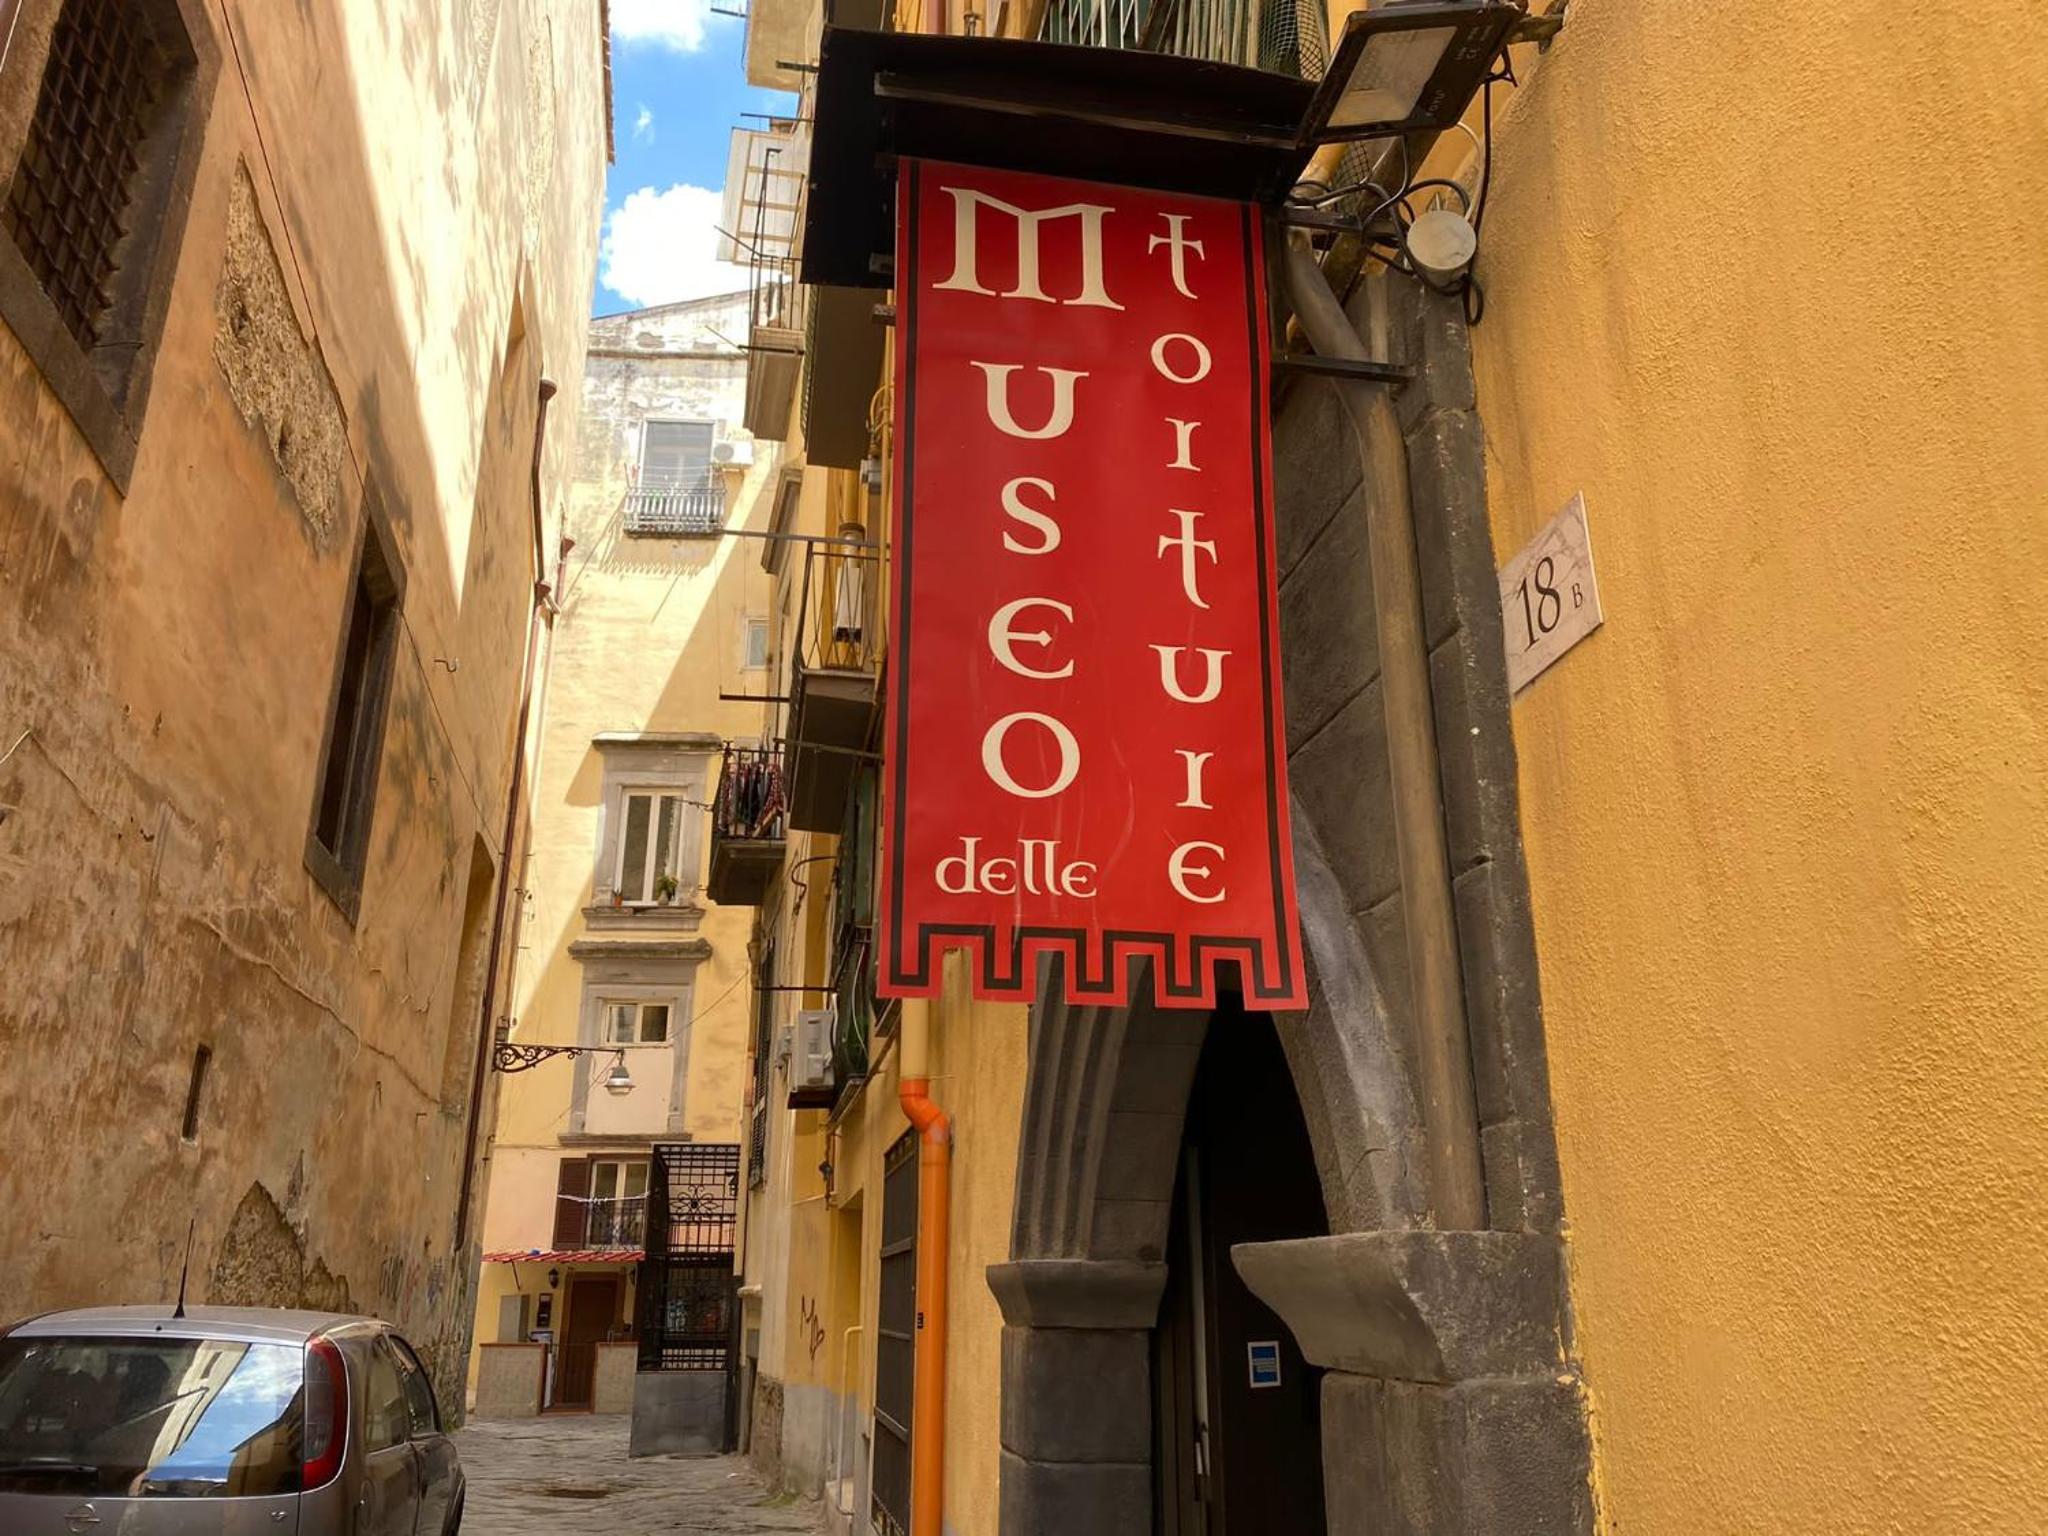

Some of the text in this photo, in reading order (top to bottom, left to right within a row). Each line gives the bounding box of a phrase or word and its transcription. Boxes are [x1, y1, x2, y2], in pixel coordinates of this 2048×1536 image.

[1516, 556, 1584, 652] 18 B
[935, 836, 1098, 898] delle
